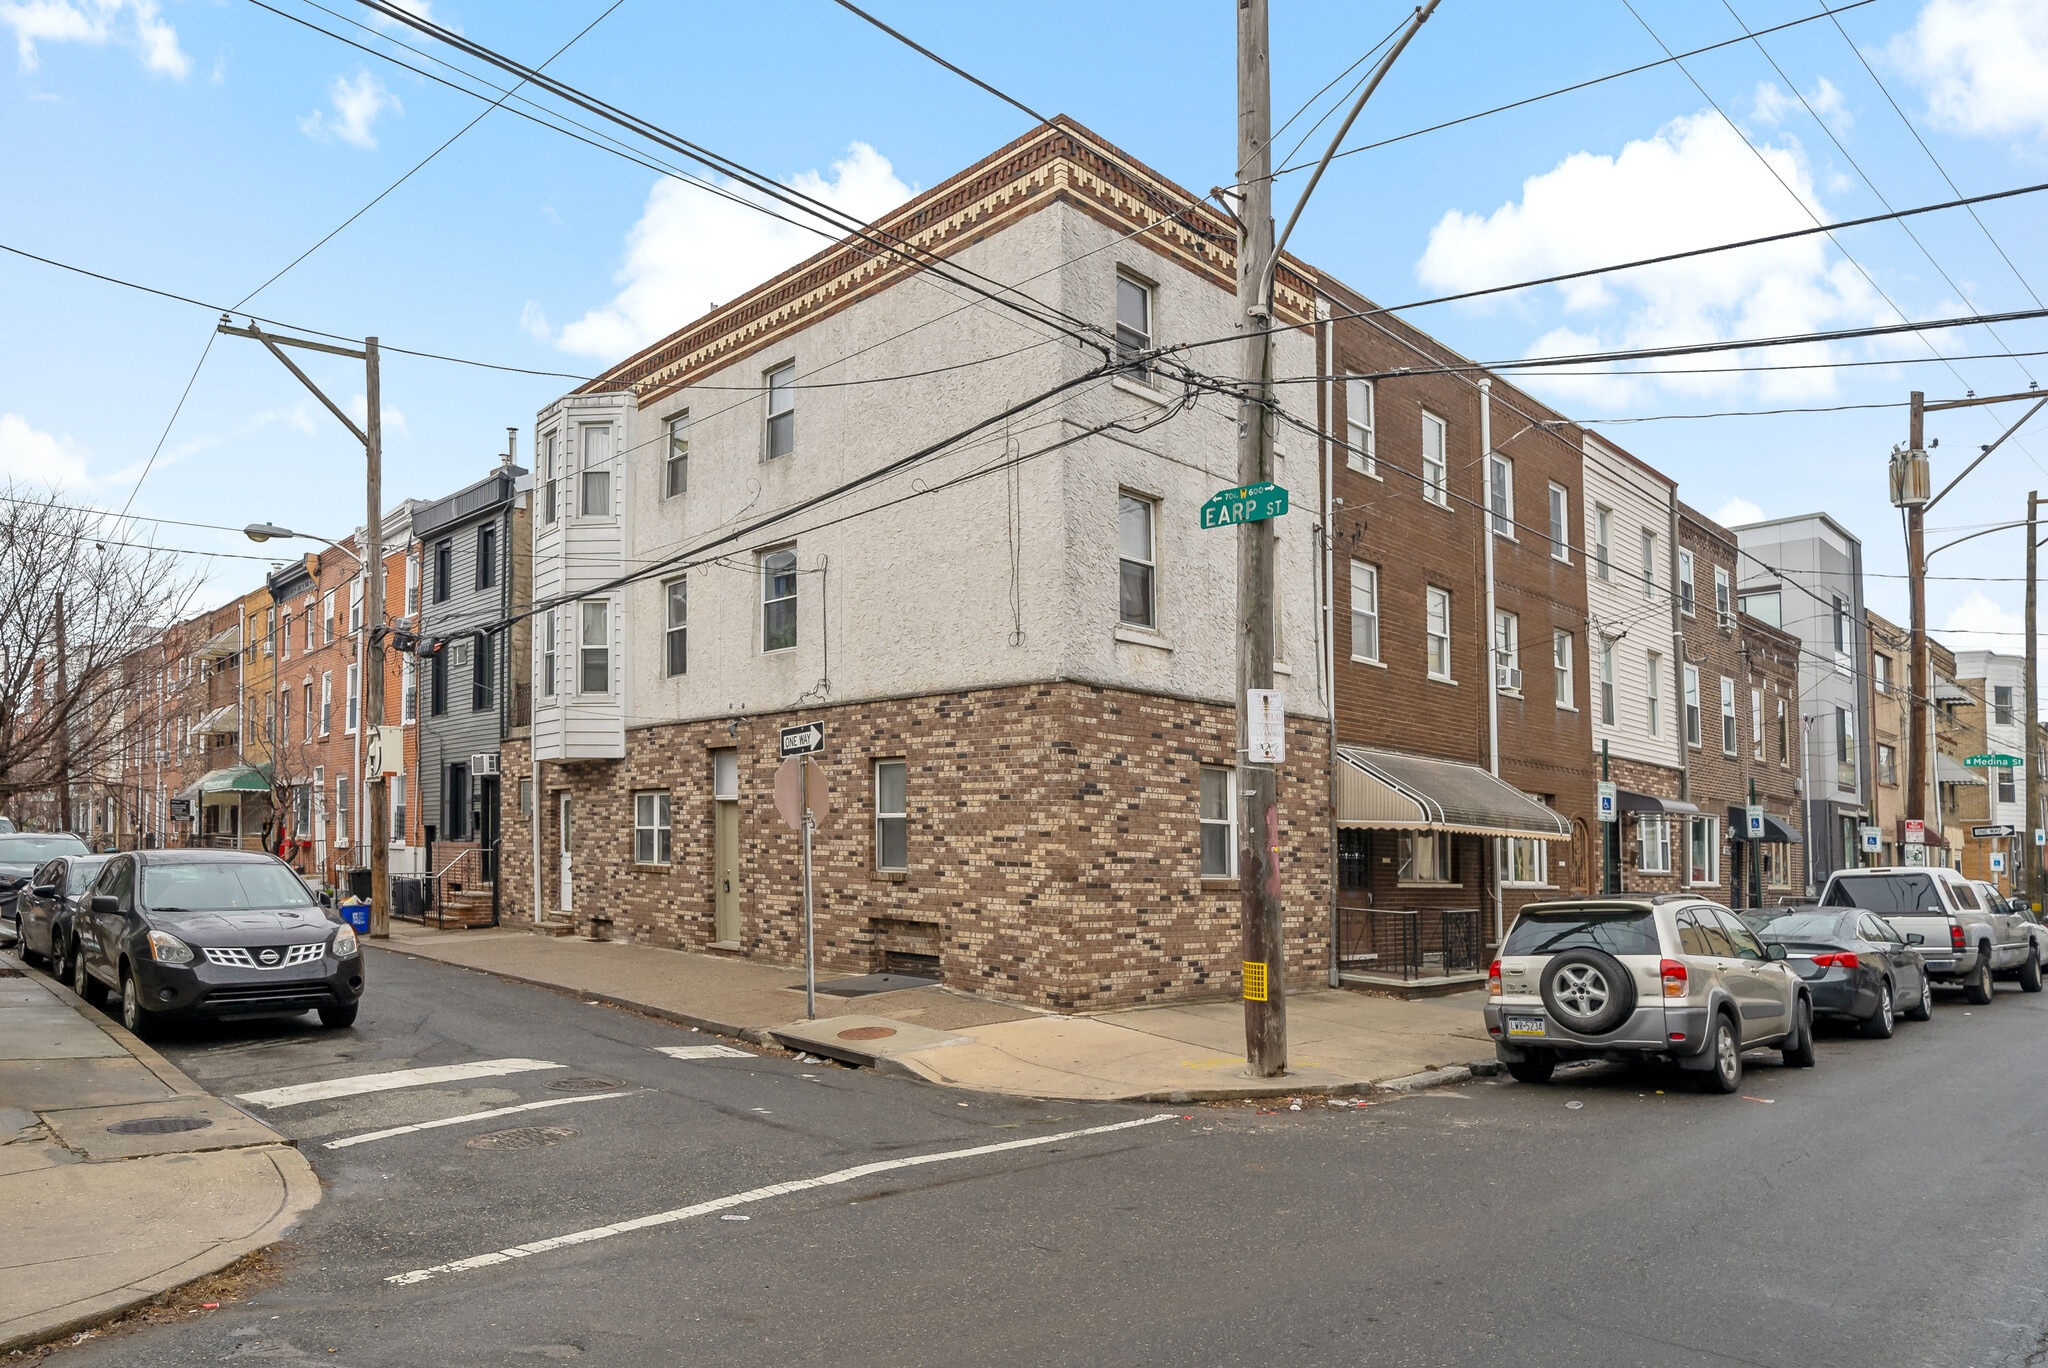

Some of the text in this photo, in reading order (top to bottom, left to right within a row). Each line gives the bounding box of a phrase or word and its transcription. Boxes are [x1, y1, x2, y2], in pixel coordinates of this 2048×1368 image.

[1240, 488, 1247, 499] W
[1248, 486, 1264, 496] 600
[1205, 499, 1282, 527] EARP ST
[785, 732, 812, 748] ONE WAY
[1973, 758, 2022, 766] Medina St
